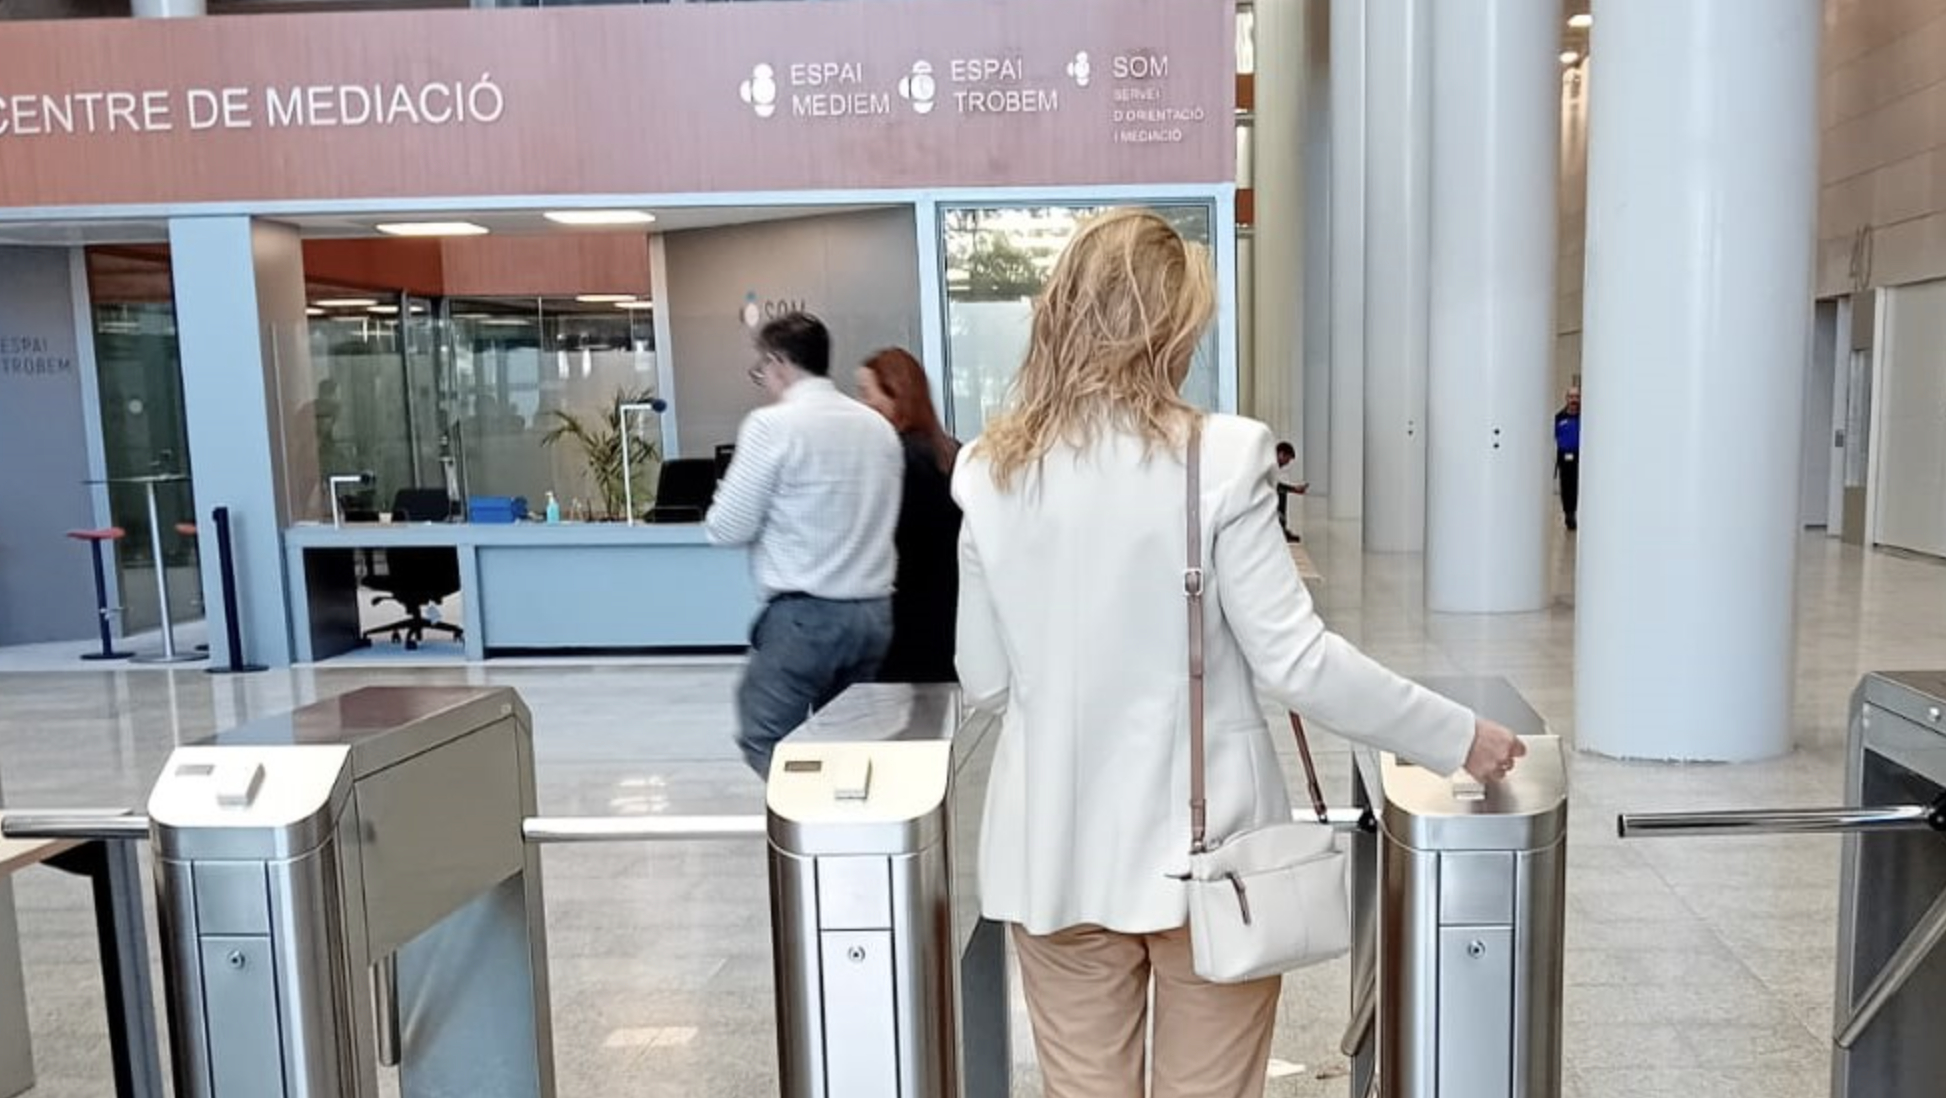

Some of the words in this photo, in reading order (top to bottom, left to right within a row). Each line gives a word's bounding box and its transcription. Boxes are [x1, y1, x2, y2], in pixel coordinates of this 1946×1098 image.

[790, 62, 862, 85] ESPAI
[950, 58, 1022, 81] ESPAI
[1112, 55, 1168, 78] SOM
[0, 91, 172, 134] ENTRE
[187, 88, 251, 129] DE
[266, 72, 503, 127] MEDIACIÓ
[792, 93, 890, 116] MEDIEM
[953, 89, 1058, 113] TROBEM
